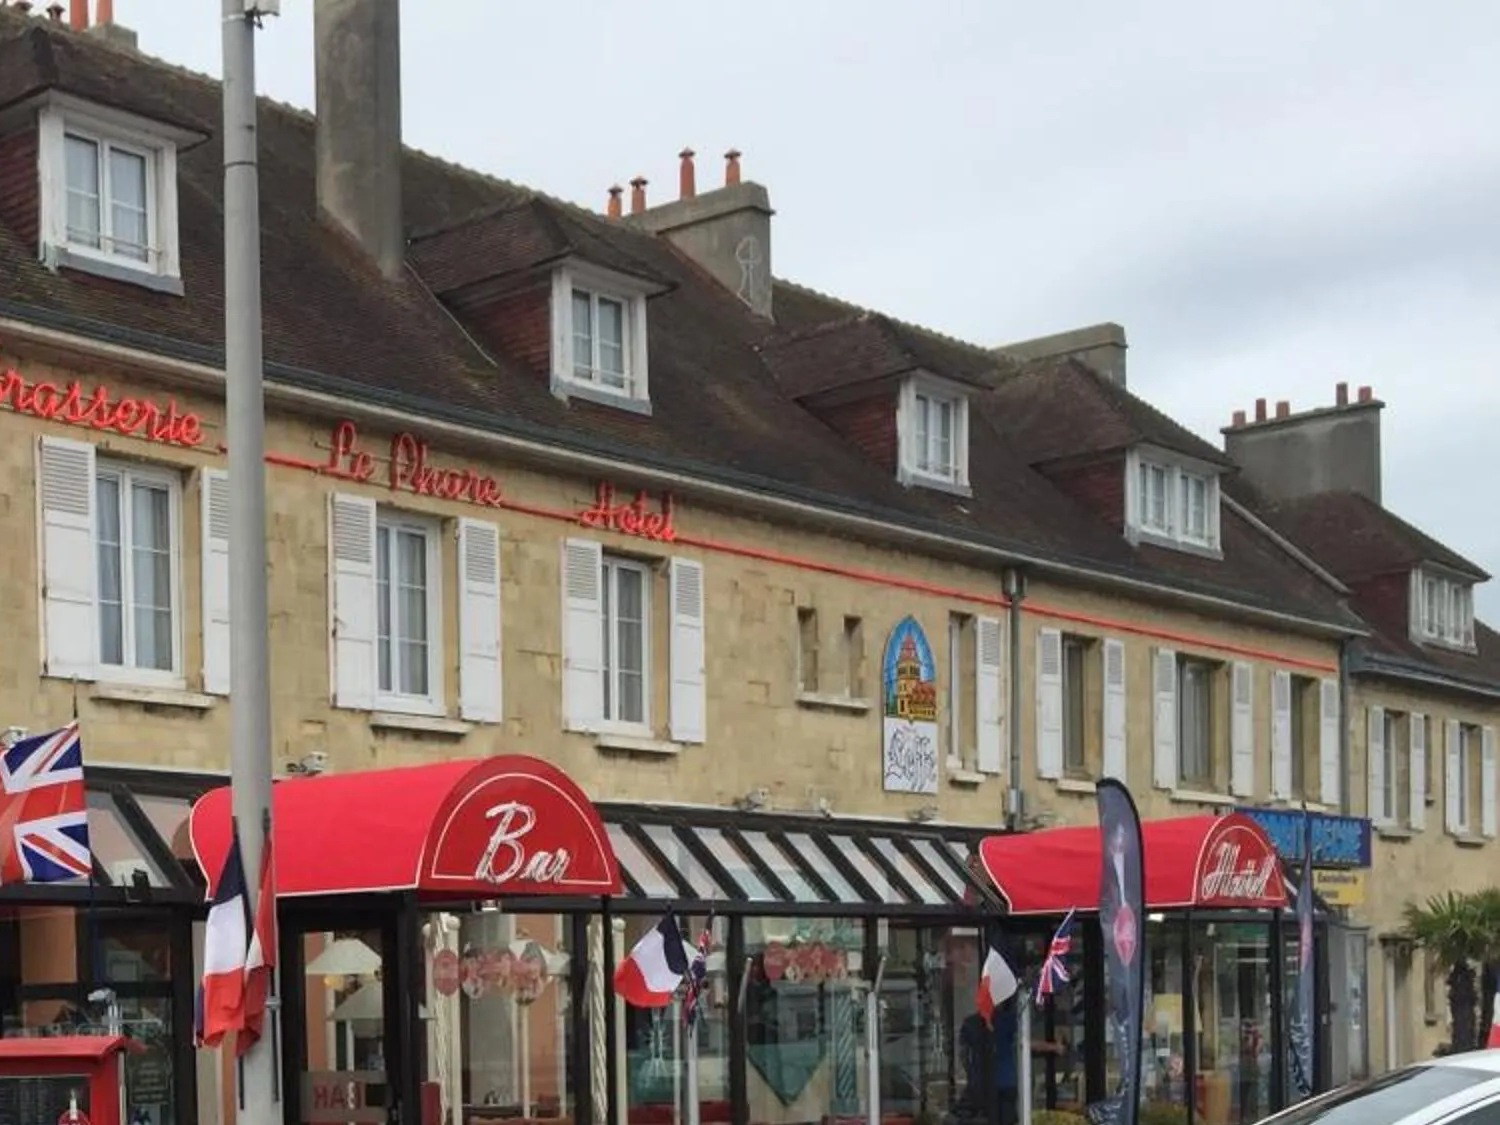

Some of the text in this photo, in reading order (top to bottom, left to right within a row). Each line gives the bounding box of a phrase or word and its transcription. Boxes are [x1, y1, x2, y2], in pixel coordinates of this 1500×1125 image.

[324, 419, 502, 508] Le Phare
[474, 800, 570, 884] Bar
